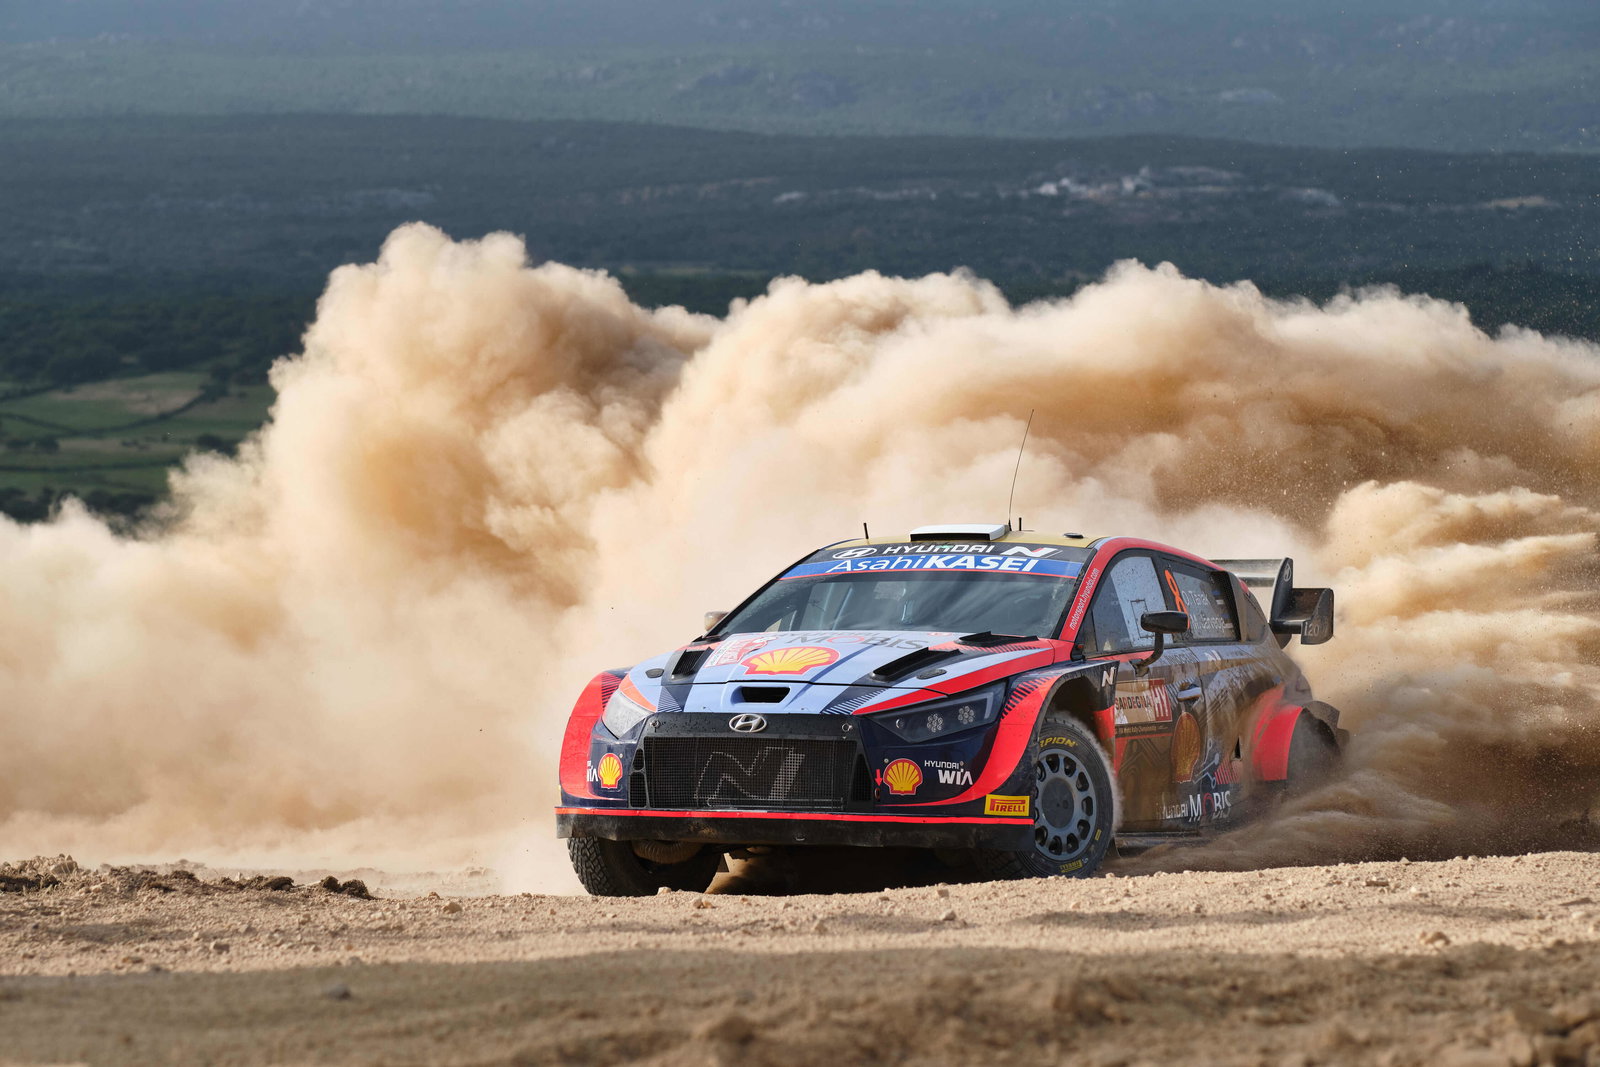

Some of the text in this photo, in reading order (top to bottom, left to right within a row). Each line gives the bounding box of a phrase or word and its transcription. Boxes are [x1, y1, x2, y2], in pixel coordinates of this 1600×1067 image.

[882, 543, 994, 555] HYUNDAI
[1069, 567, 1100, 631] motorsport.hyundai.com
[1101, 666, 1116, 687] N
[1114, 690, 1153, 711] SARDEGNA
[924, 760, 960, 770] HYUNDAI
[989, 797, 1027, 813] PIRELLI
